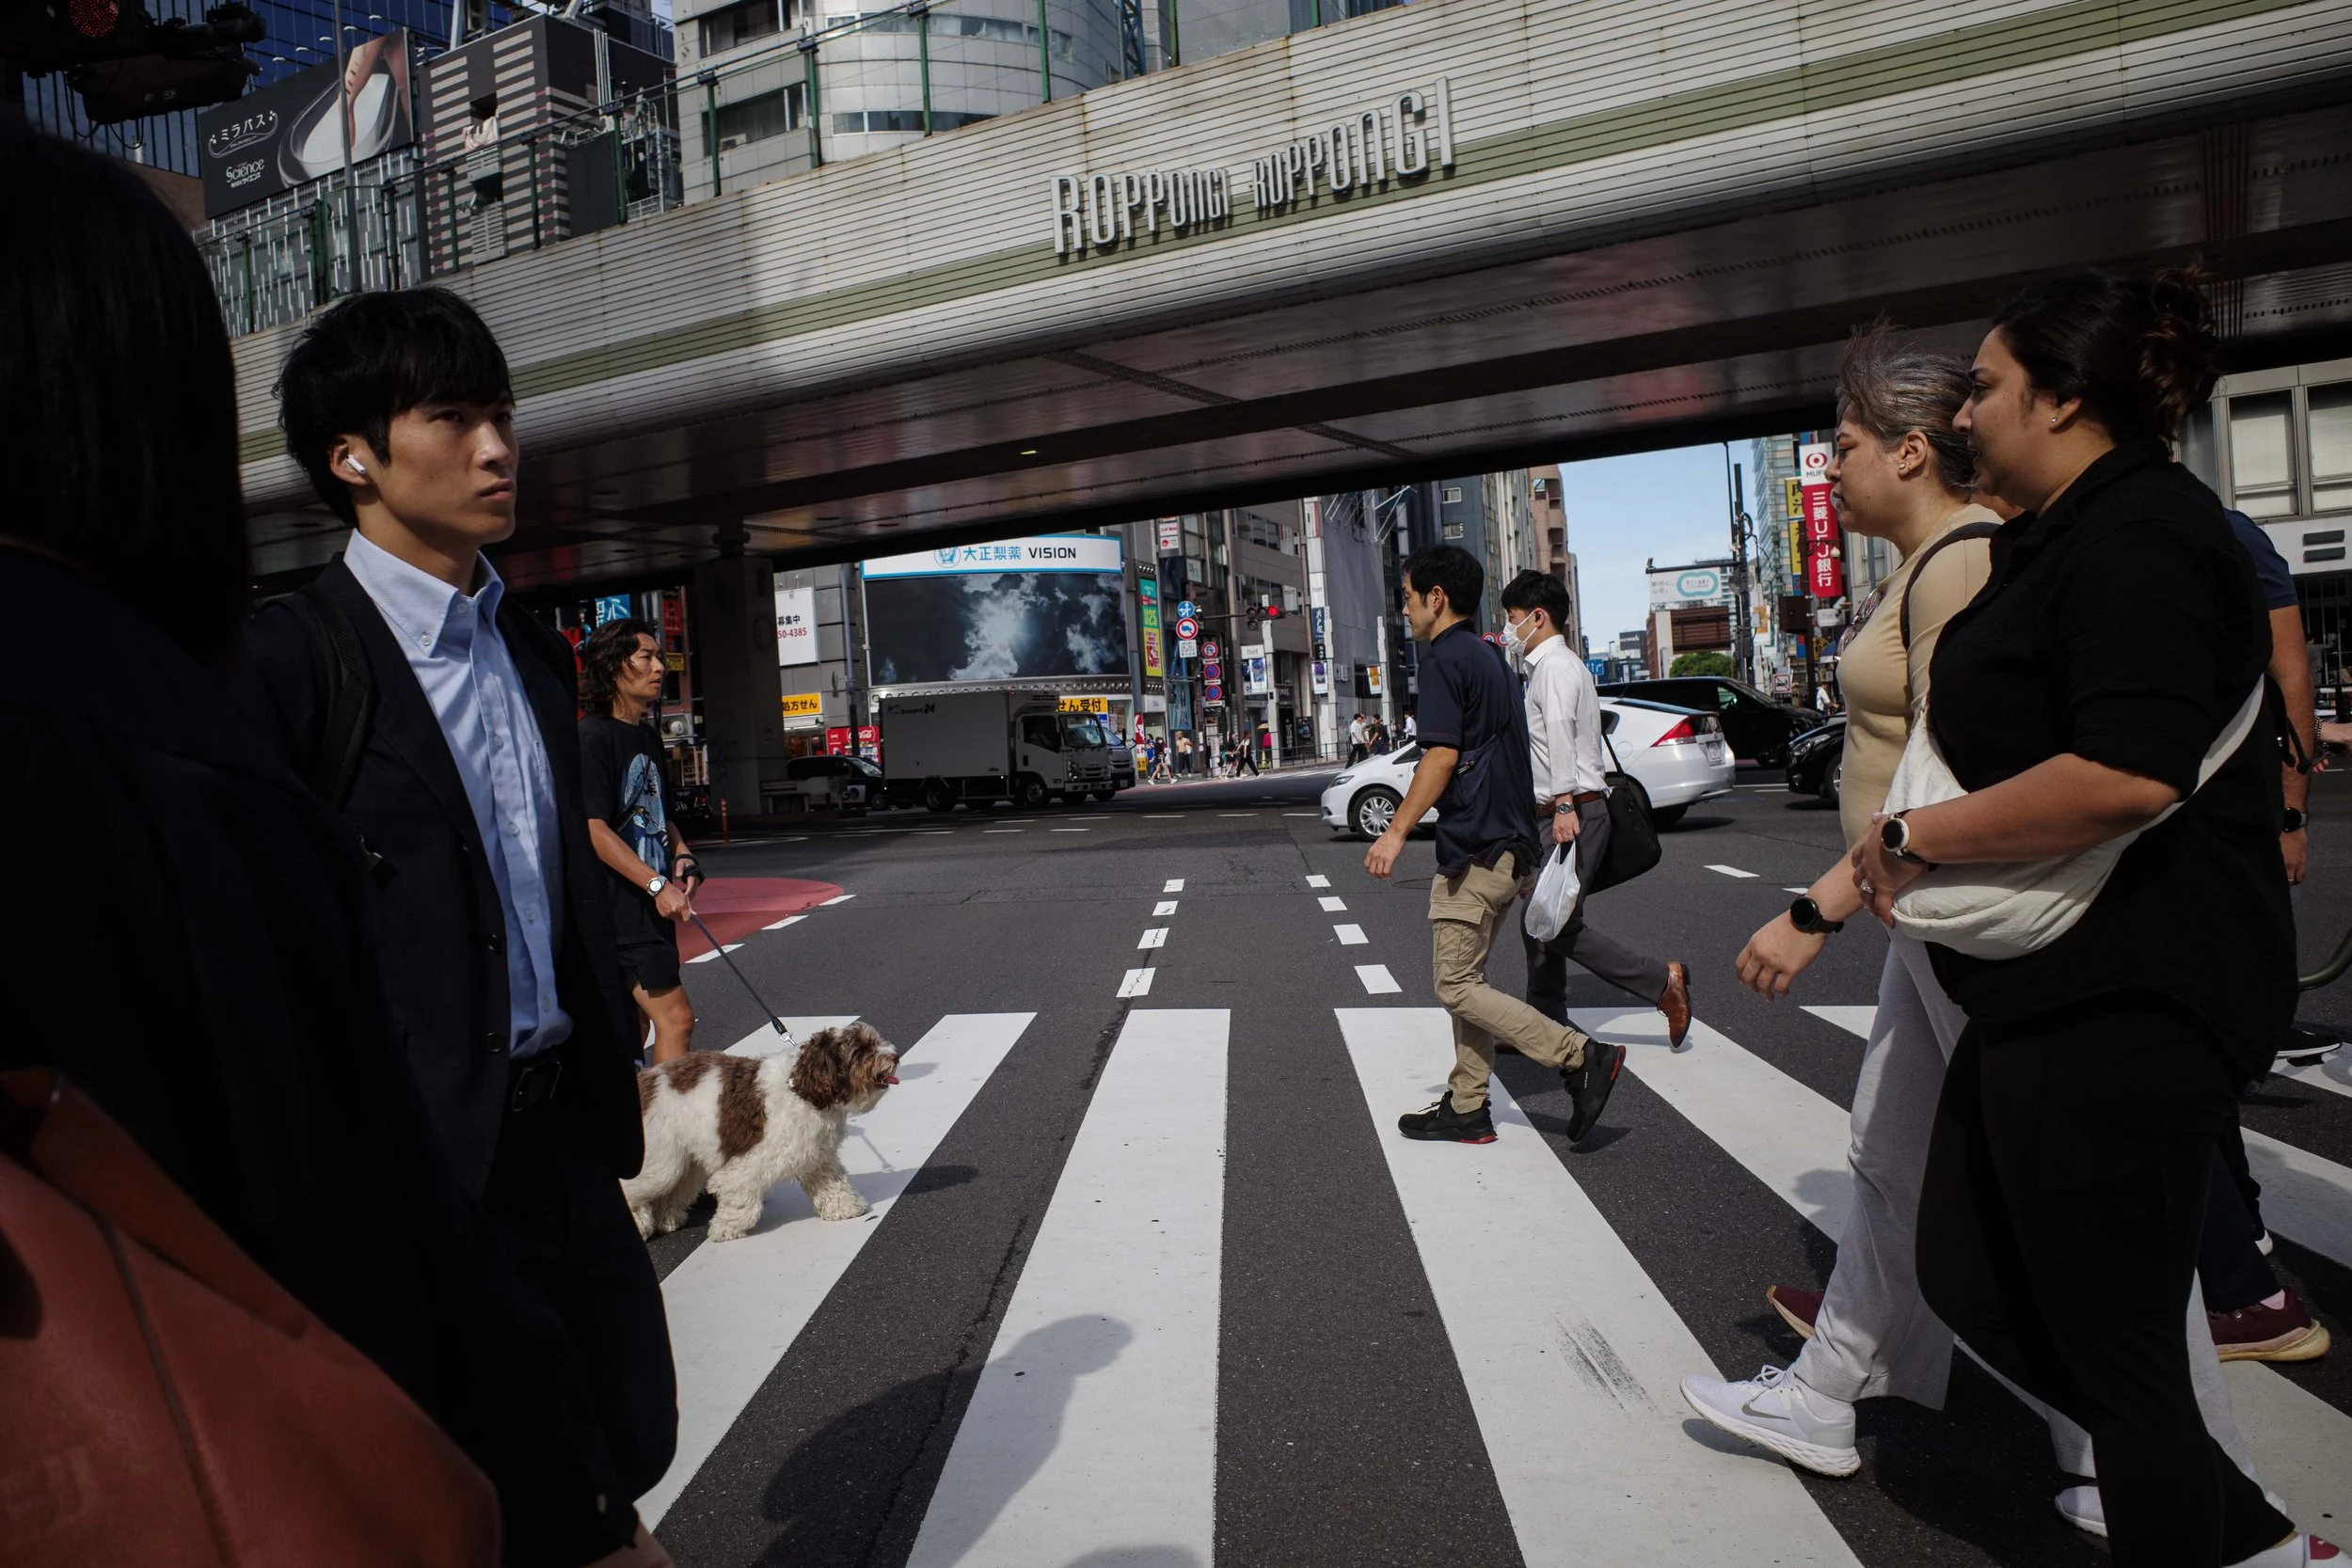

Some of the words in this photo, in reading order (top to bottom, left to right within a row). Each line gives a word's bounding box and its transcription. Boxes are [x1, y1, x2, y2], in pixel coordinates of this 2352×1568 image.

[226, 159, 265, 182] Science
[1050, 167, 1232, 255] ROPPONGI
[1251, 76, 1454, 209] ROPPONGI
[963, 546, 1022, 562] 大正製薬
[1028, 546, 1076, 559] VISION
[778, 614, 801, 626] 募集中
[777, 627, 807, 639] 50-4385
[924, 704, 935, 714] 24
